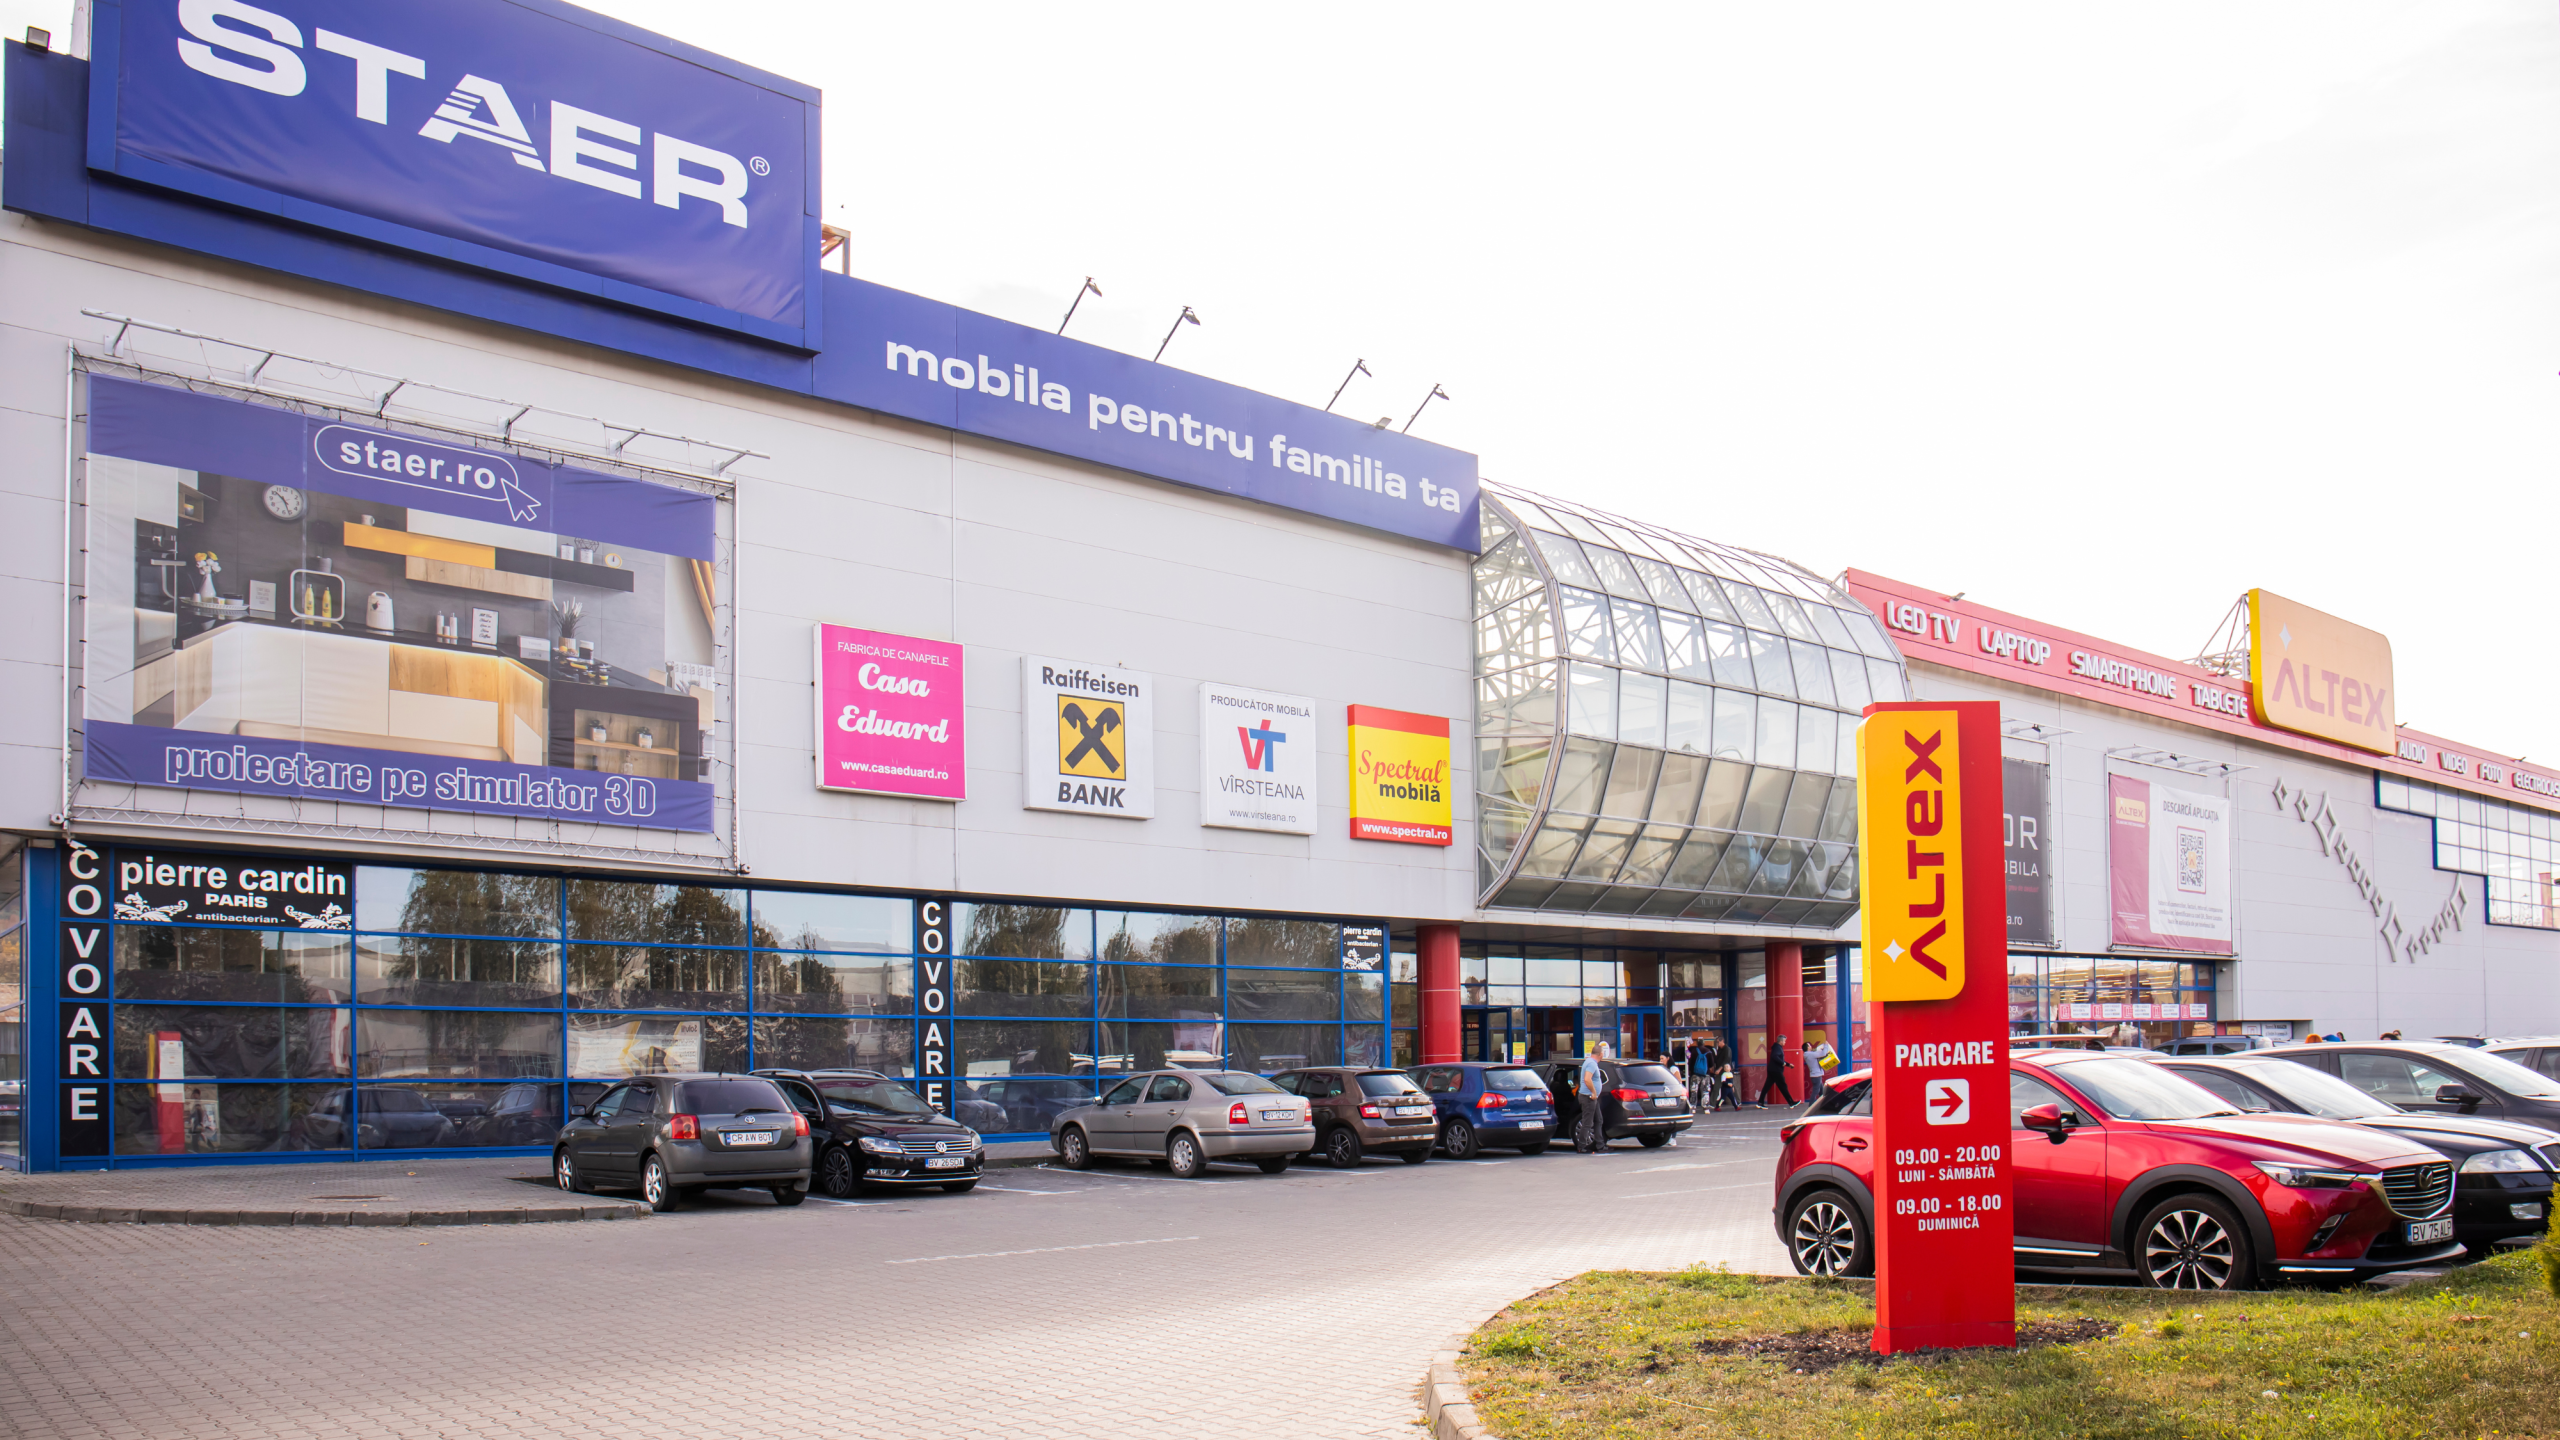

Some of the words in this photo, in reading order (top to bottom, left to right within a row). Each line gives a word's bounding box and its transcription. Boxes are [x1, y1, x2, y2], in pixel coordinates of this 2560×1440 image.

[886, 340, 1071, 414] mobila
[1089, 392, 1253, 461] pentru
[1269, 434, 1406, 499] familia
[1419, 477, 1460, 513] ta
[339, 437, 496, 491] staer.ro
[837, 641, 880, 658] FABRICA
[882, 648, 896, 660] DE
[898, 650, 949, 667] CANAPELE
[1886, 600, 1927, 634] LED
[1930, 613, 1960, 643] TV
[1980, 626, 2050, 665] LAPTOP
[2071, 651, 2176, 699] SMARTPHONE
[2192, 684, 2248, 718] TABLETE
[858, 662, 930, 697] Casa
[1042, 665, 1139, 698] Raiffeisen
[1211, 694, 1274, 712] PRODUCĂTOR
[1276, 704, 1310, 718] MOBILĂ
[837, 704, 949, 744] Eduard
[841, 761, 949, 781] www.casaeduard.ro
[2398, 740, 2427, 764] AUDIO
[2440, 751, 2467, 774] VIDEO
[2481, 762, 2503, 783] FOTO
[166, 744, 372, 793] proiectare
[381, 766, 427, 802] pe
[435, 768, 597, 813] simulator
[604, 777, 656, 818] 3D
[1220, 774, 1305, 801] VÎRSTEANA
[1379, 782, 1441, 803] mobilă
[1057, 782, 1126, 809] BANK
[2163, 800, 2192, 817] DESCARCĂ
[1229, 809, 1297, 823] www.virsteana.ro
[1361, 823, 1448, 840] www.spectral.ro
[121, 856, 228, 891] pierre
[238, 866, 346, 896] cardin
[195, 912, 279, 924] antibacterian
[1343, 926, 1361, 936] pierre
[1363, 927, 1382, 936] cardin
[66, 848, 102, 1121] COVOARE
[922, 901, 945, 1107] COVOARE
[1895, 1041, 1995, 1067] PARCARE
[732, 1134, 743, 1142] CR
[746, 1133, 756, 1142] AW
[1895, 1147, 1939, 1165] 09.00
[1956, 1145, 2001, 1162] 20.00
[1898, 1169, 1926, 1183] LUNI
[1938, 1163, 1996, 1181] SÂMBĂTĂ
[1896, 1197, 1940, 1215] 09.00
[1957, 1194, 2002, 1212] 18.00
[1918, 1213, 1980, 1232] DUMINICĂ
[2412, 1225, 2426, 1241] BV
[2429, 1222, 2439, 1239] 75
